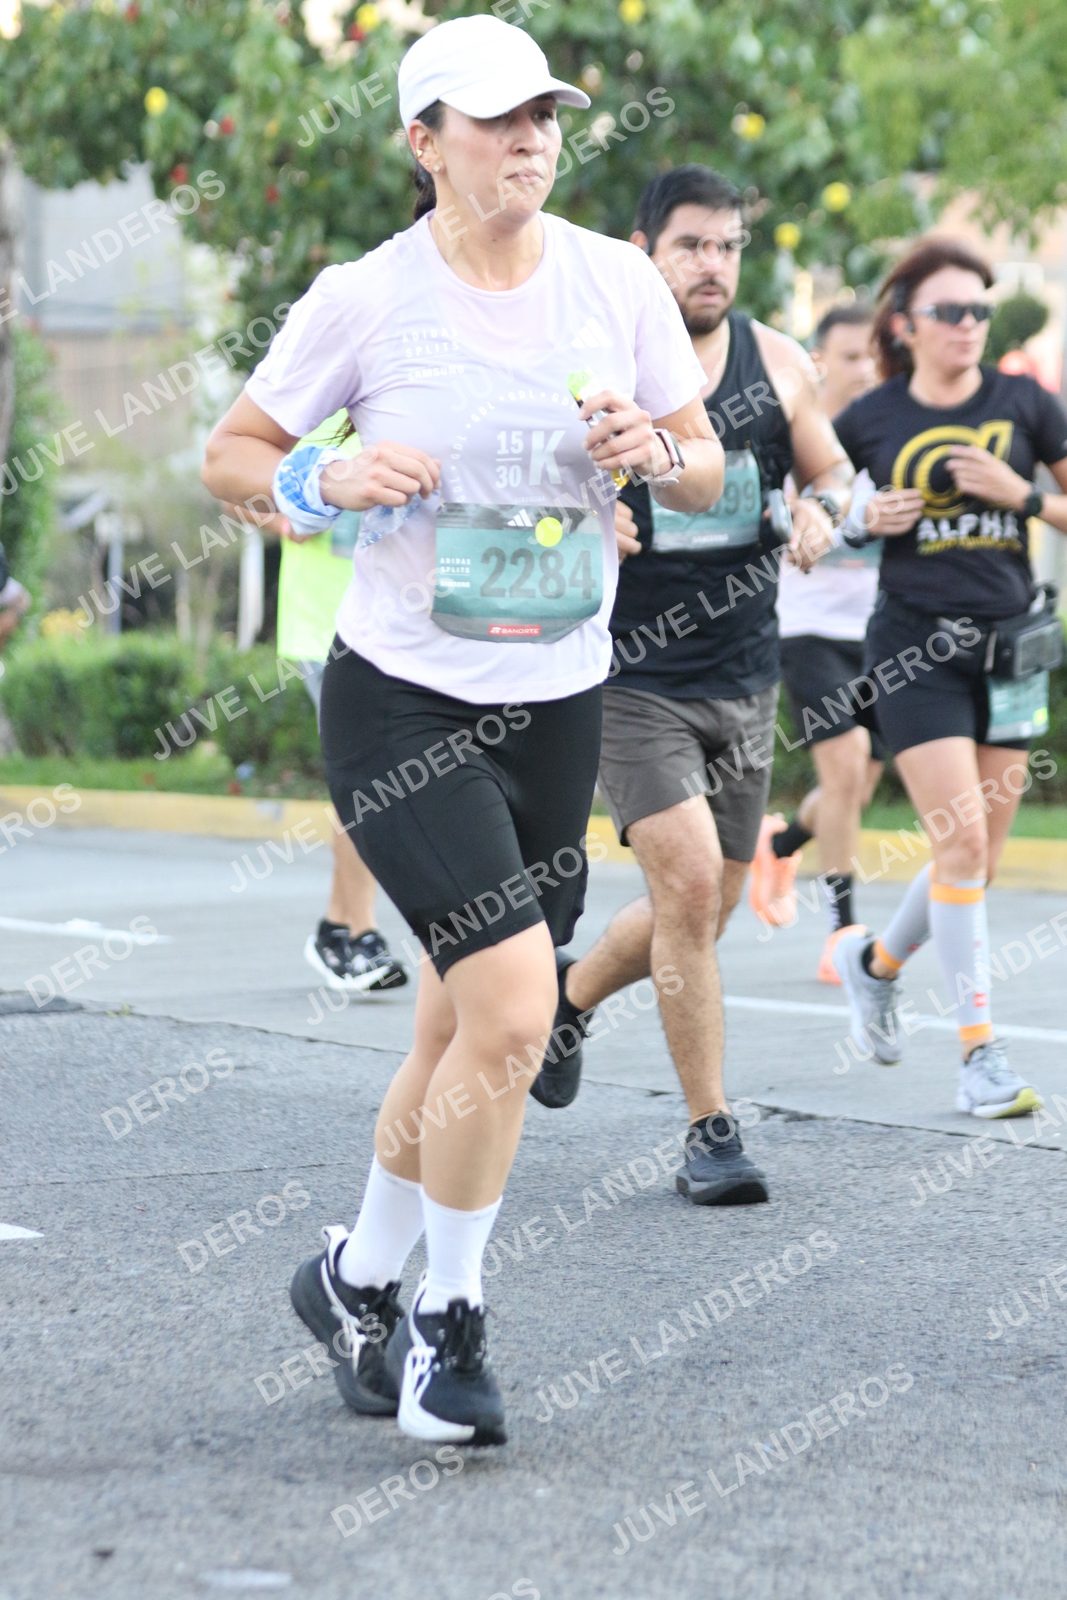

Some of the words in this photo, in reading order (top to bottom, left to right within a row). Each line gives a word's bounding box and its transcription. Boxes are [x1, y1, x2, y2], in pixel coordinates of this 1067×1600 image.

[496, 430, 524, 455] 15
[528, 430, 566, 486] K
[495, 465, 522, 489] 30
[916, 509, 1018, 543] ALPHA
[480, 546, 597, 600] 2284
